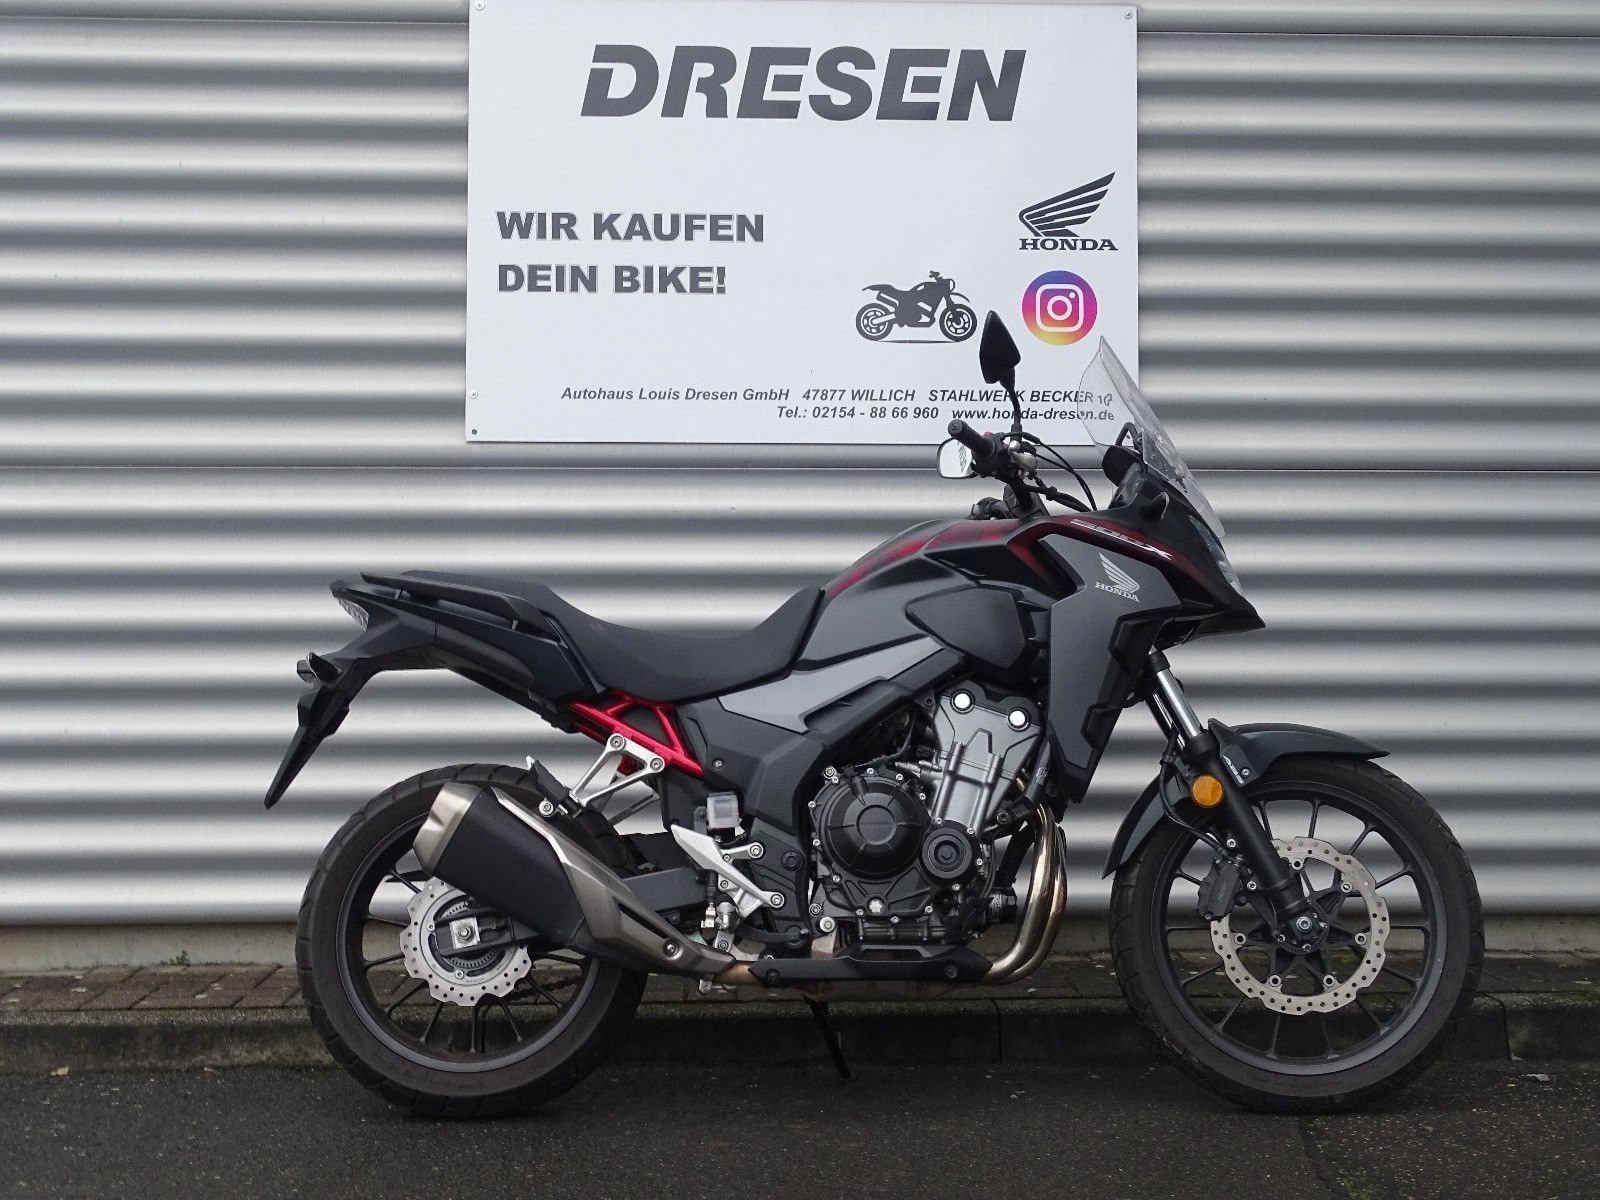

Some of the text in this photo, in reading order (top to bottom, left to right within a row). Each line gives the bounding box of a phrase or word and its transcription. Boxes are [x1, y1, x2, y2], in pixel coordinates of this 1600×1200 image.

[580, 44, 1027, 122] DRESEN
[497, 211, 764, 242] WIR KAUFEN
[1018, 237, 1119, 251] HONDA
[498, 264, 727, 295] DEIN BIKE!
[560, 387, 634, 400] Autohaus
[638, 387, 680, 401] Louis
[684, 388, 738, 401] Dresen
[742, 388, 790, 401] GmbH
[802, 388, 847, 401] 47877
[851, 389, 916, 401] WILLICH
[1029, 390, 1094, 403] BECKER
[777, 406, 808, 418] Tel.:
[812, 406, 856, 419] 02154
[869, 406, 887, 419] 88
[891, 406, 909, 419] 66
[912, 406, 939, 419] 960
[1094, 581, 1140, 603] HONDA
